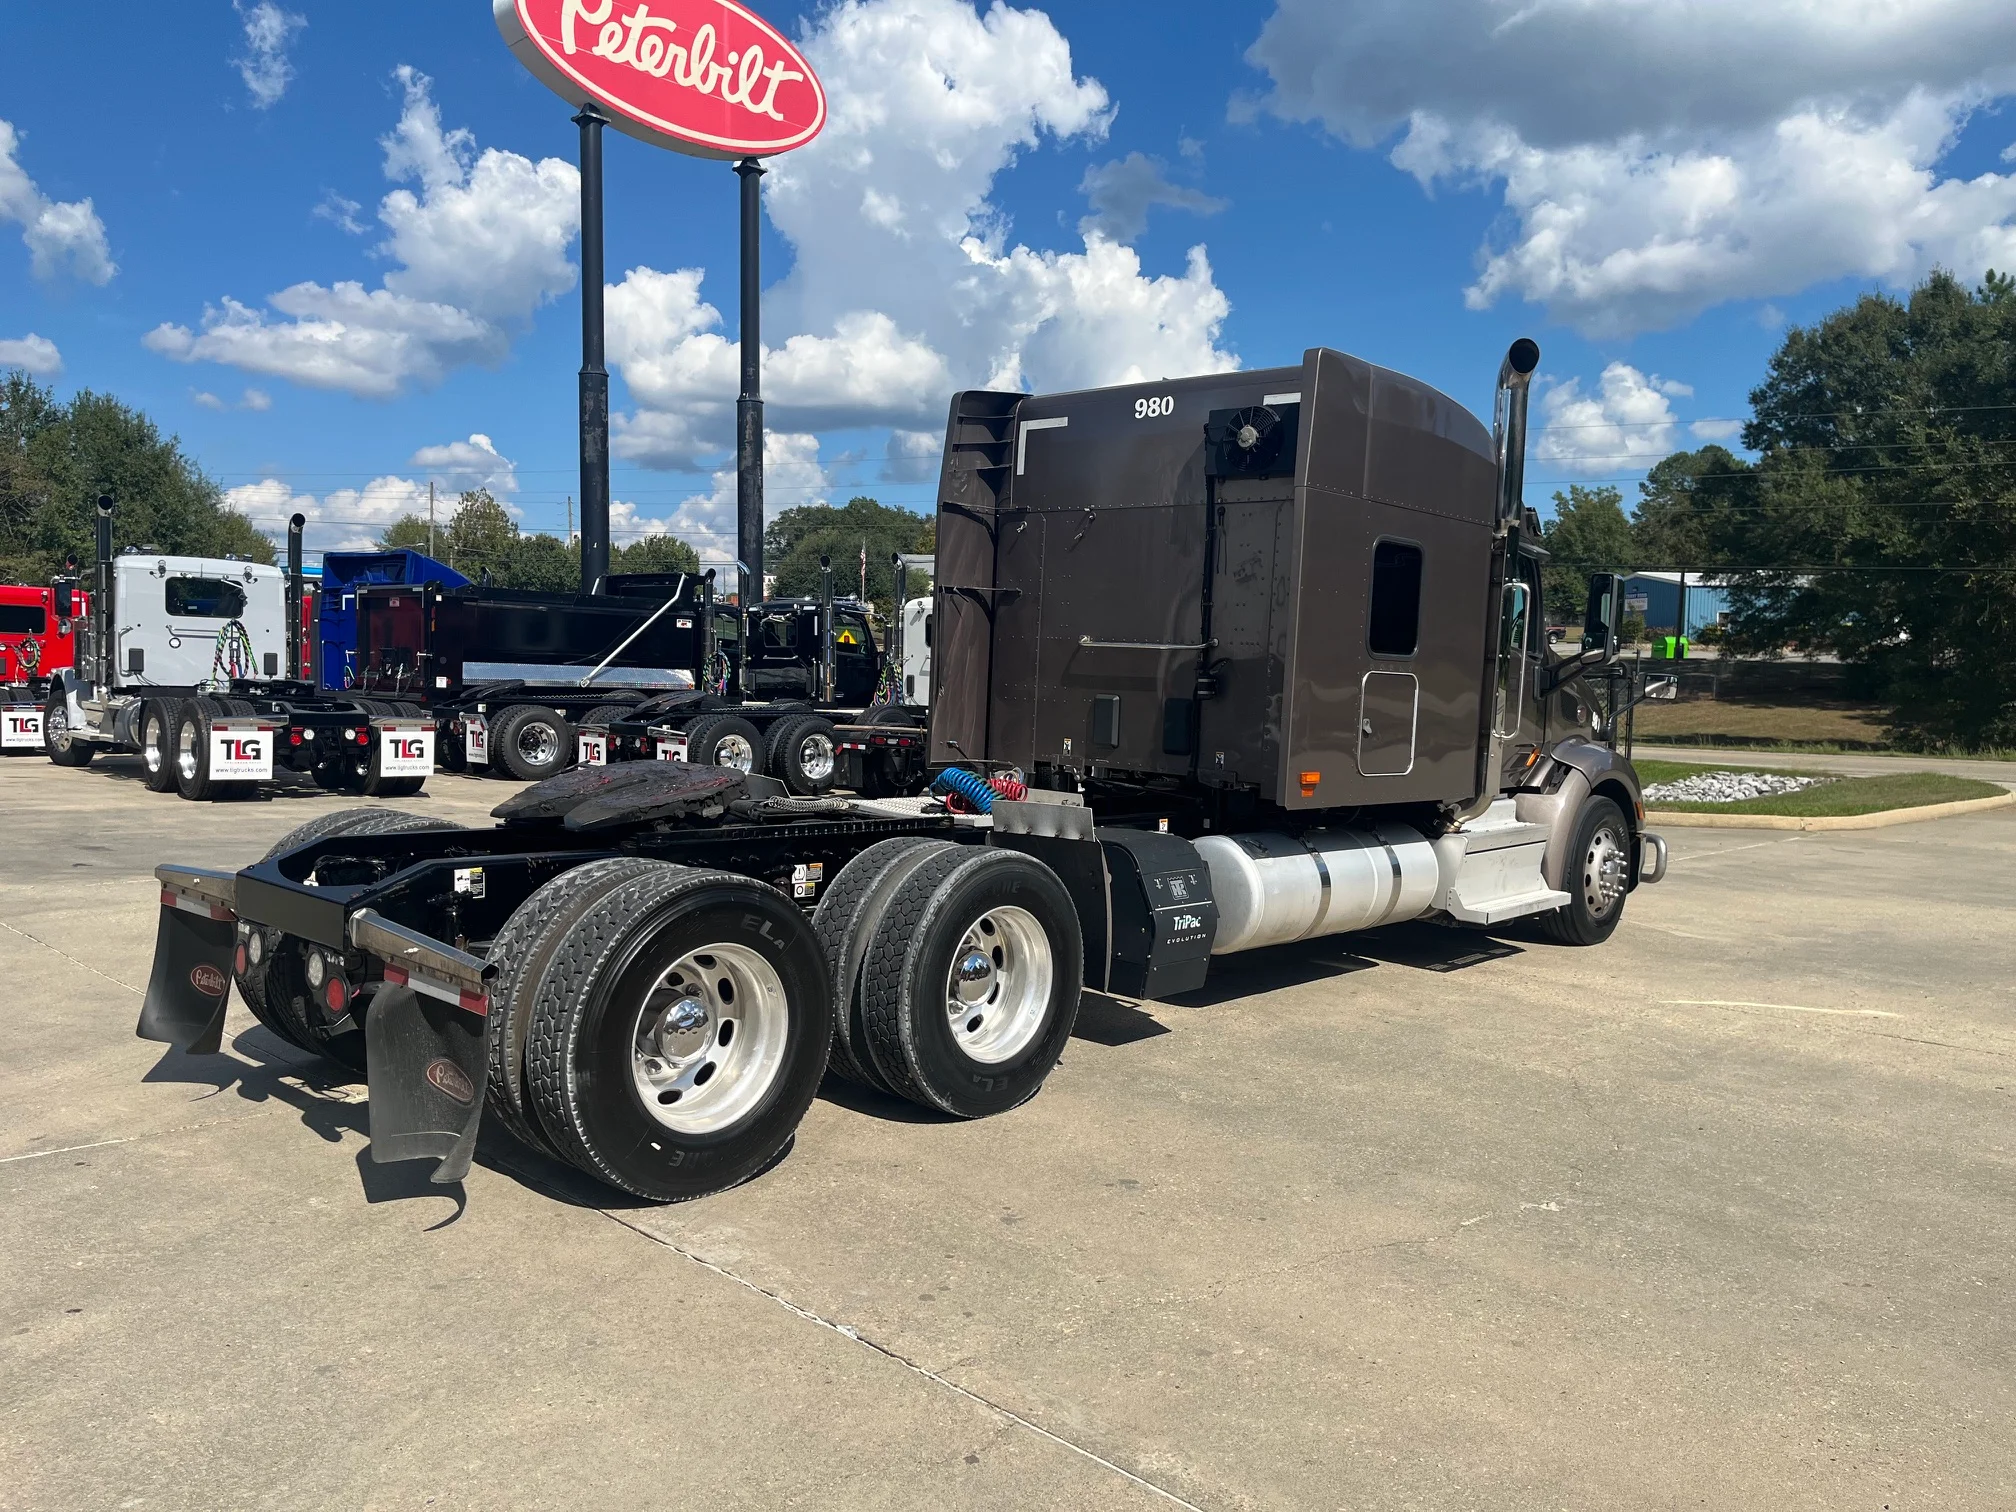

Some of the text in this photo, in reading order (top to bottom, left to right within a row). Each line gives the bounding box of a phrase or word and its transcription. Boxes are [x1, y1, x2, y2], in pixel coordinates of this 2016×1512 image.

[561, 0, 804, 121] Peterbilt
[1134, 395, 1174, 419] 980
[8, 717, 39, 733] TLG
[389, 738, 424, 759] TLG
[469, 730, 484, 748] TLG
[220, 739, 261, 760] TLG
[583, 742, 601, 761] TLG
[1173, 914, 1202, 931] TriPac
[1166, 933, 1207, 945] EVOLUTION
[195, 969, 223, 991] Peterbilt
